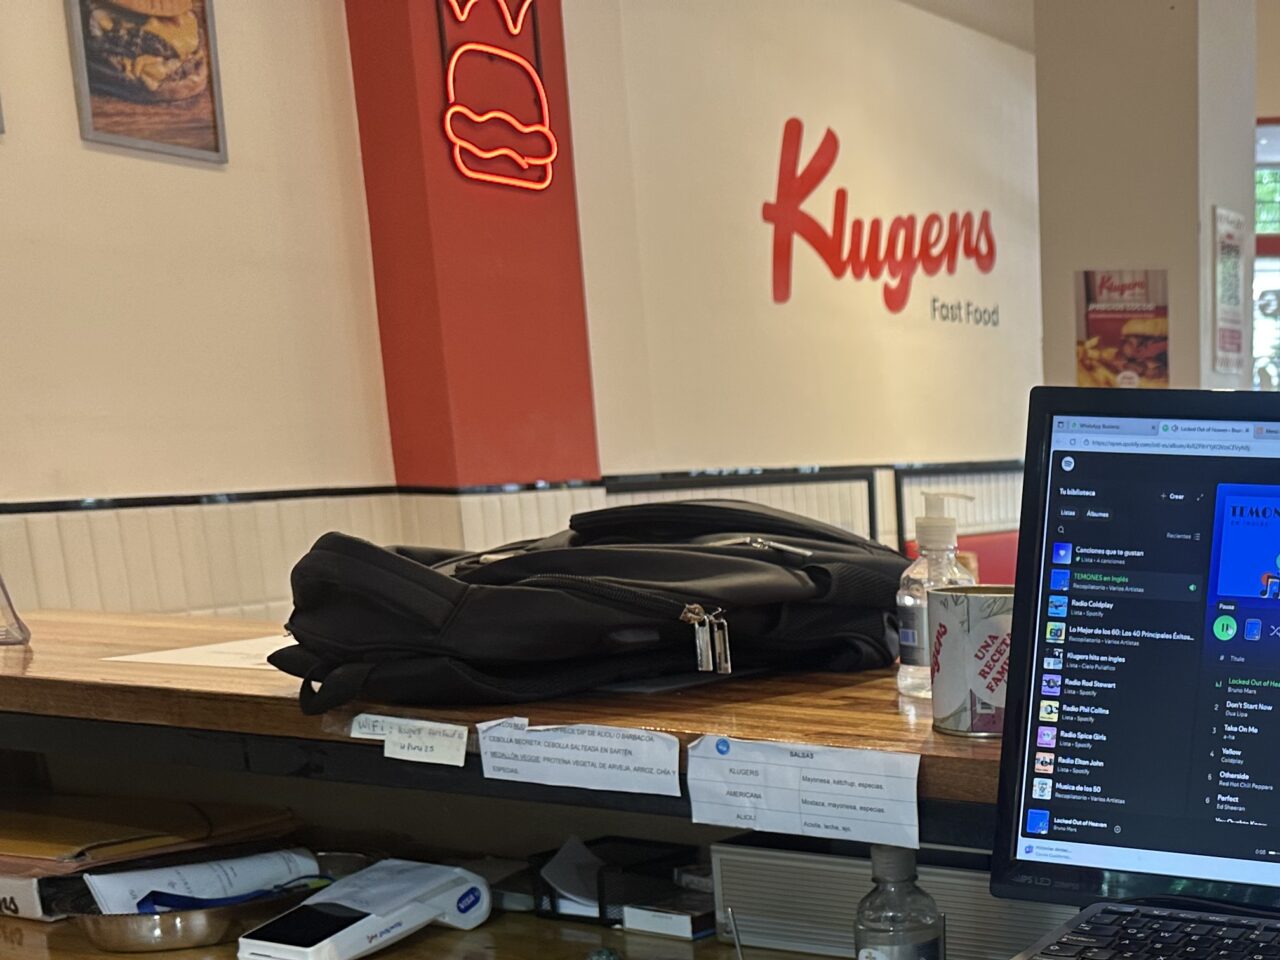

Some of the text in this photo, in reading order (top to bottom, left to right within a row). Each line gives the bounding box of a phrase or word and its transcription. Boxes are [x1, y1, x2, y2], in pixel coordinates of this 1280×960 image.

[762, 117, 996, 314] Klugers
[931, 297, 999, 327] Fast Food
[1067, 488, 1095, 497] biblioteca
[1076, 546, 1104, 555] Canciones
[1074, 572, 1102, 581] TEMONES
[1071, 599, 1113, 610] Radio Coldplay
[974, 634, 999, 661] UNA
[1065, 679, 1116, 689] Radio Stewart
[1228, 677, 1250, 686] Locked
[1251, 679, 1262, 687] Out
[1263, 679, 1269, 687] of
[1062, 704, 1109, 715] Radio Phil Collins
[1226, 700, 1272, 711] Don't Start Now
[1224, 724, 1258, 734] Take On Me
[1060, 730, 1093, 741] Radio Spice
[789, 751, 814, 760] SALSAS
[1222, 747, 1242, 756] Yellow
[1058, 757, 1104, 768] Radio John
[1219, 771, 1249, 780] Otherside
[725, 790, 762, 799] AMERICANA
[1217, 794, 1239, 803] Perfect
